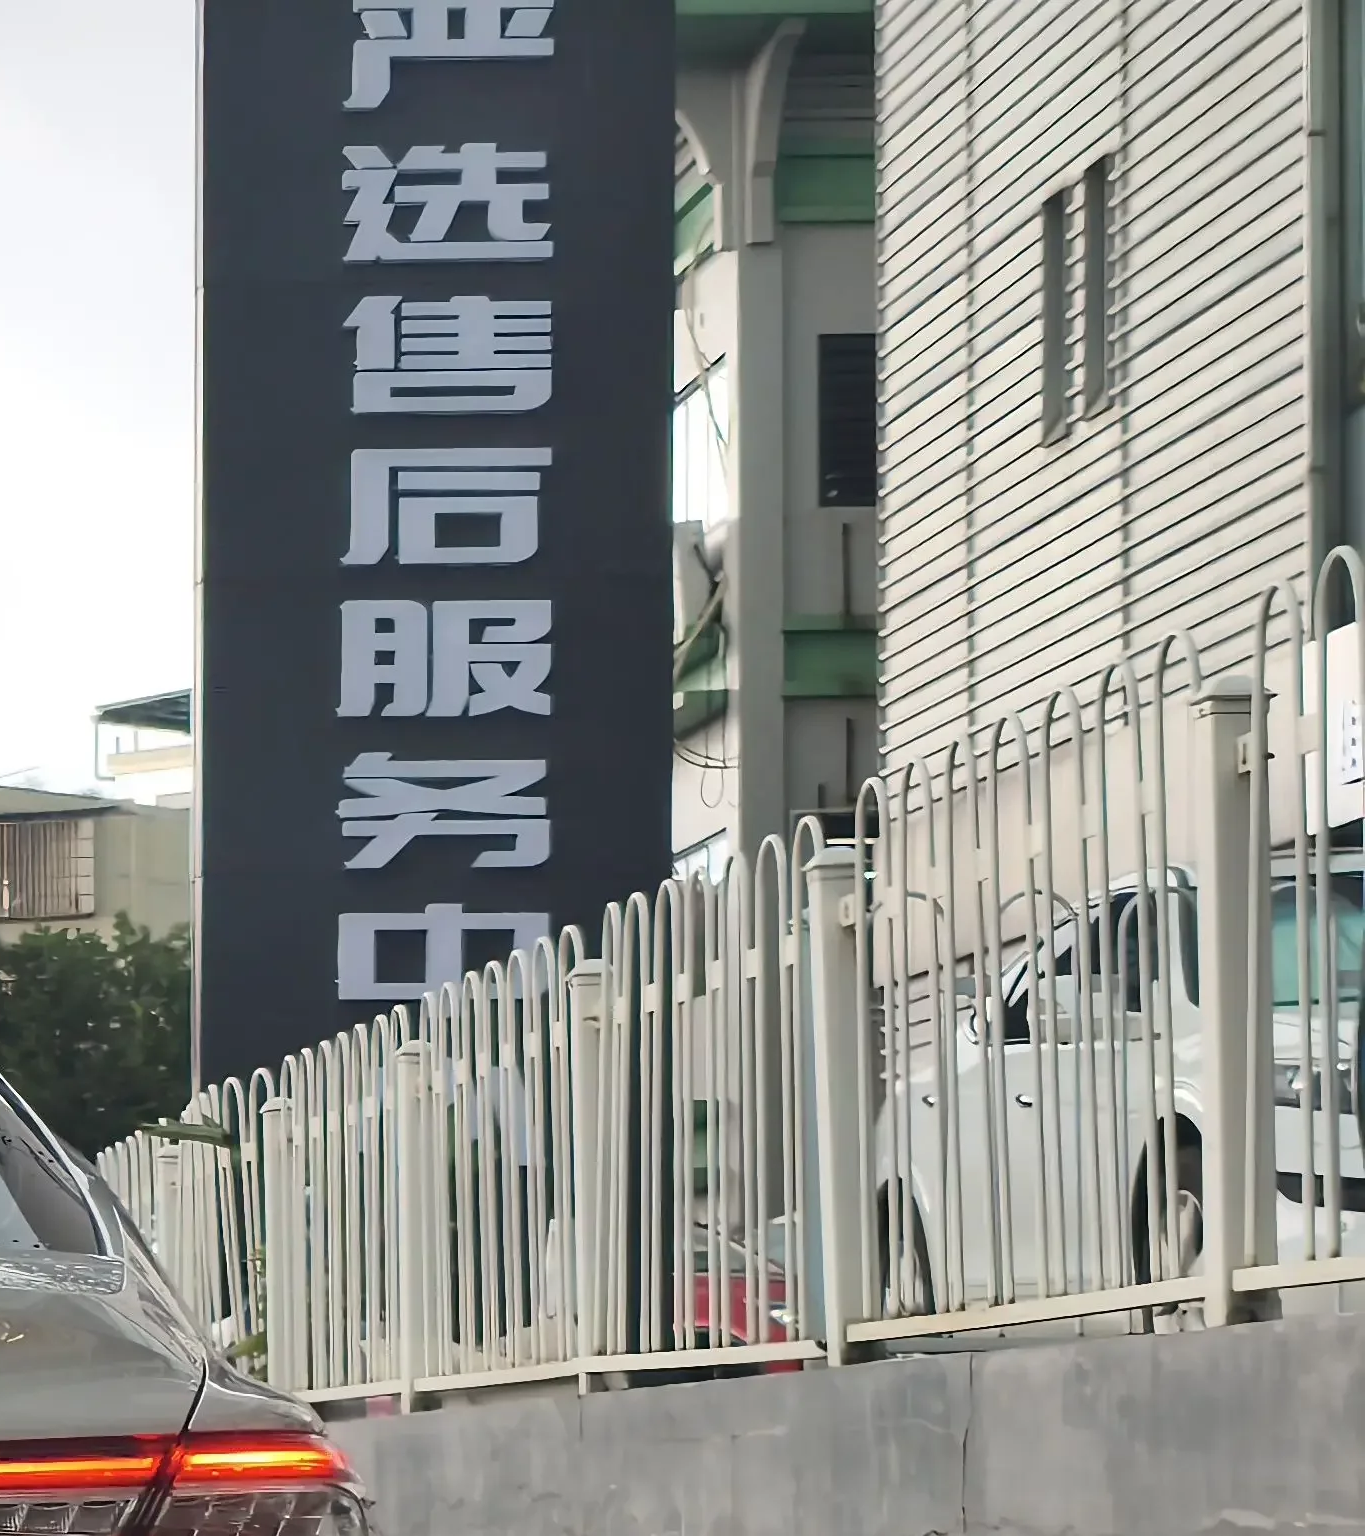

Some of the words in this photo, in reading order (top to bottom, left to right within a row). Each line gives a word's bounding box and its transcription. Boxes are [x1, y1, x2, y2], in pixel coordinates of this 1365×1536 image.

[335, 0, 556, 1166] 严选售后服务中
